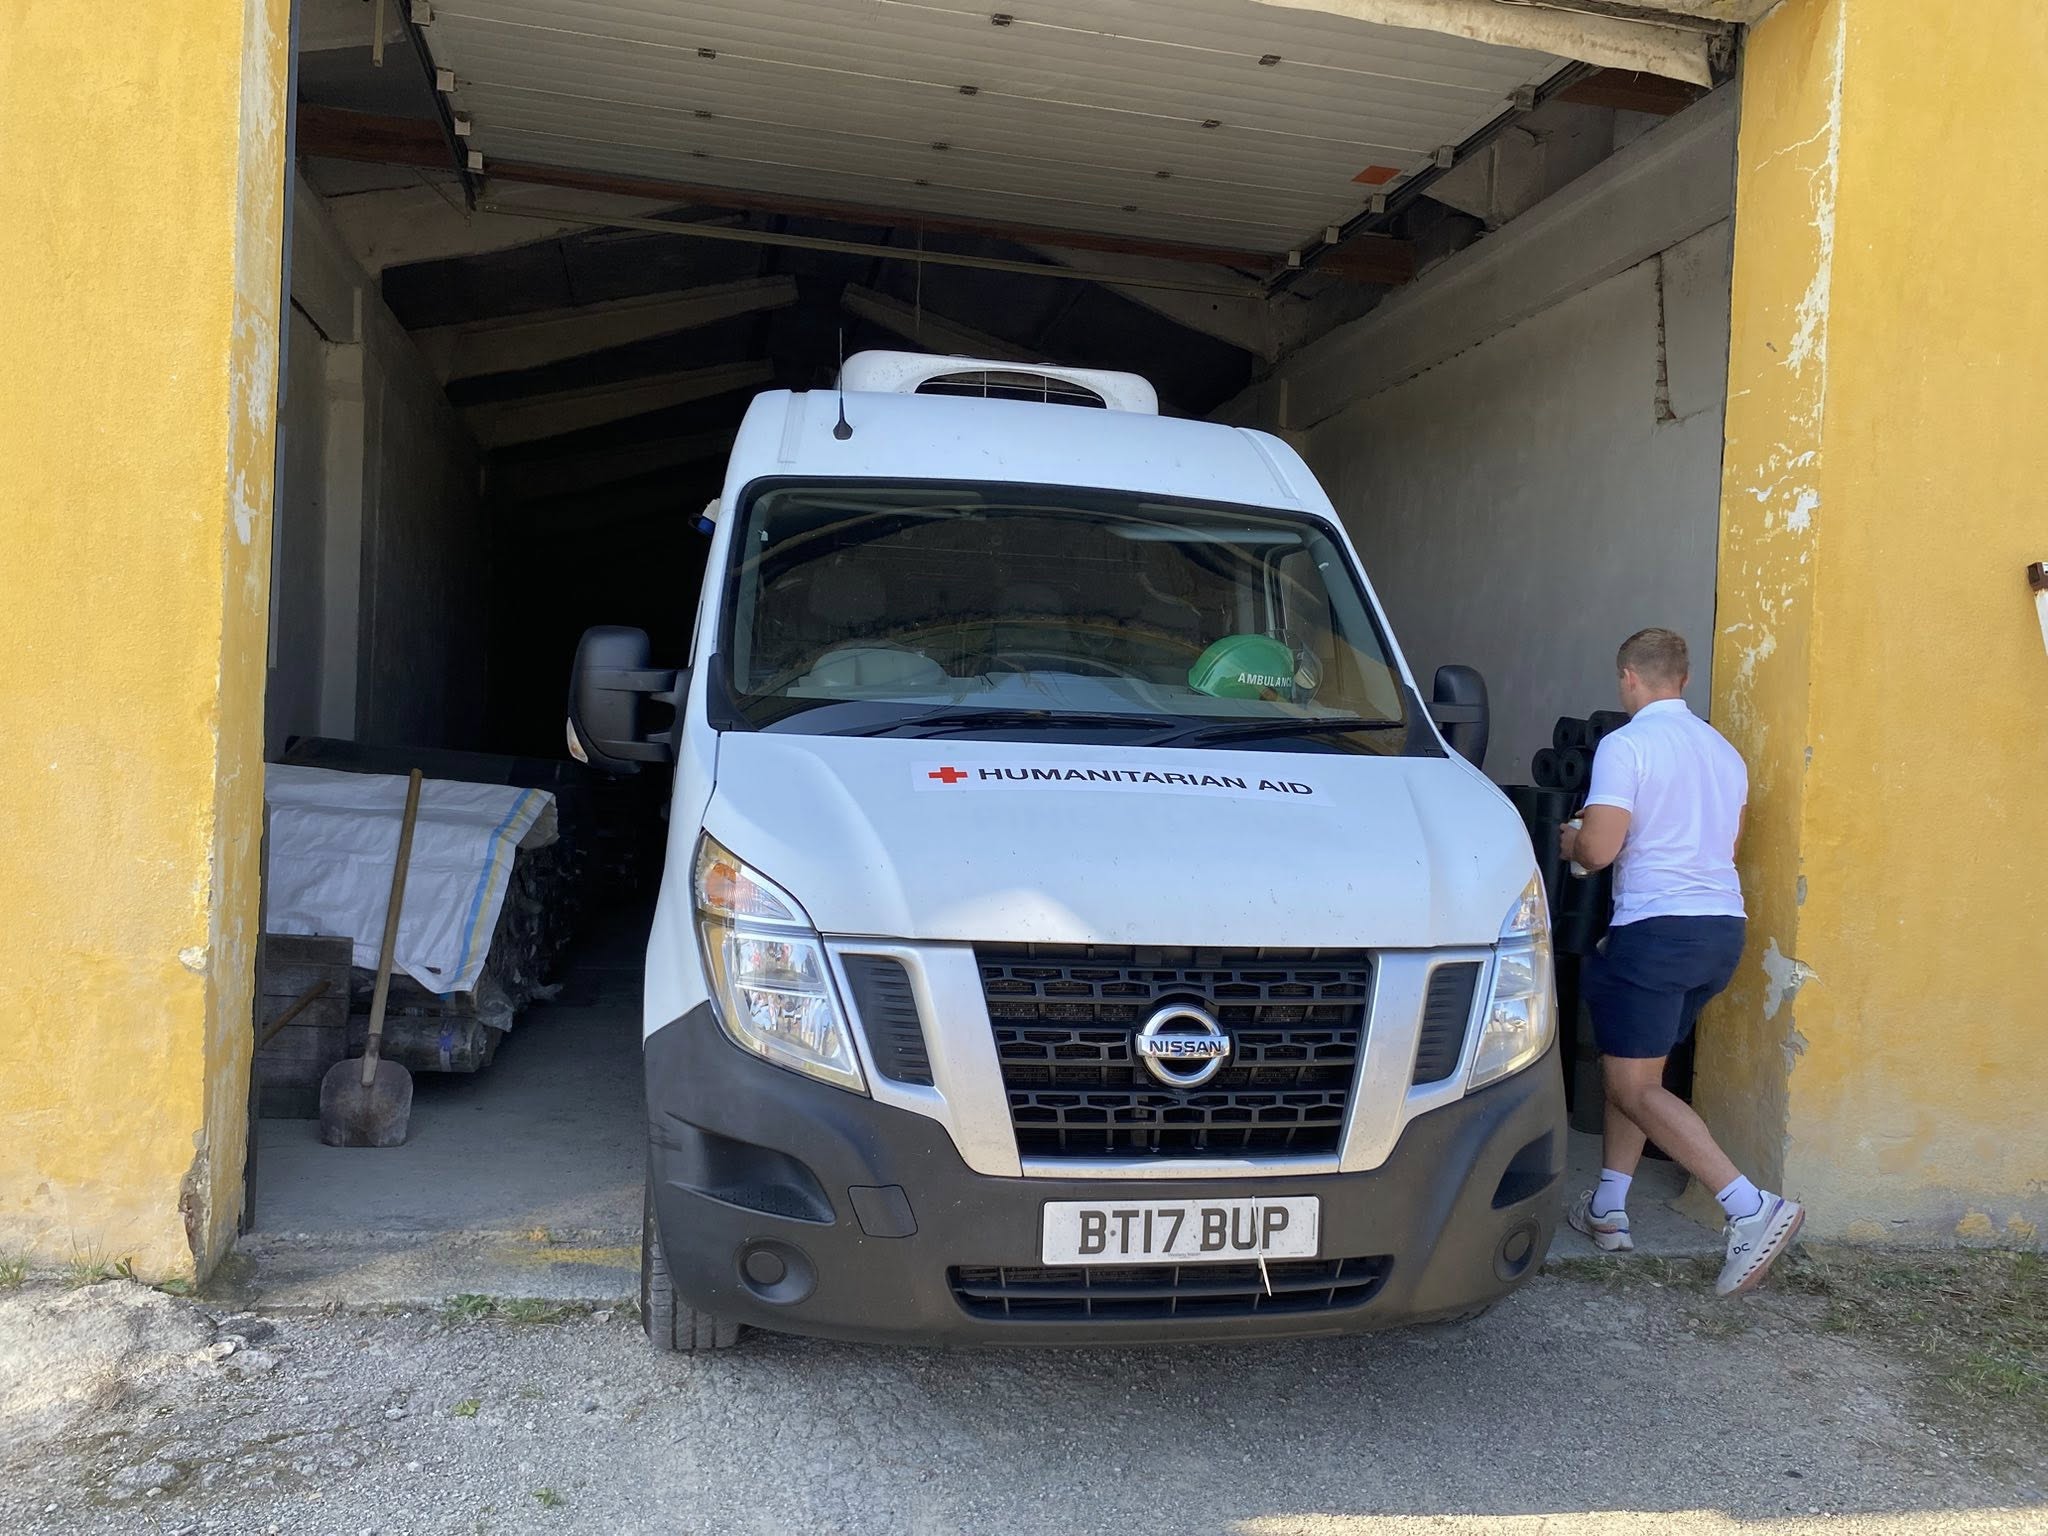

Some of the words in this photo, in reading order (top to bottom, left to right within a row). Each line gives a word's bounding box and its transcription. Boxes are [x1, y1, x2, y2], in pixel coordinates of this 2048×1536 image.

[1238, 672, 1292, 687] AMBULANC
[978, 768, 1247, 790] HUMANITARIAN
[1258, 779, 1314, 796] AID
[1149, 1040, 1222, 1053] NISSAN
[1078, 1208, 1186, 1255] BT17
[1200, 1205, 1290, 1252] BUP
